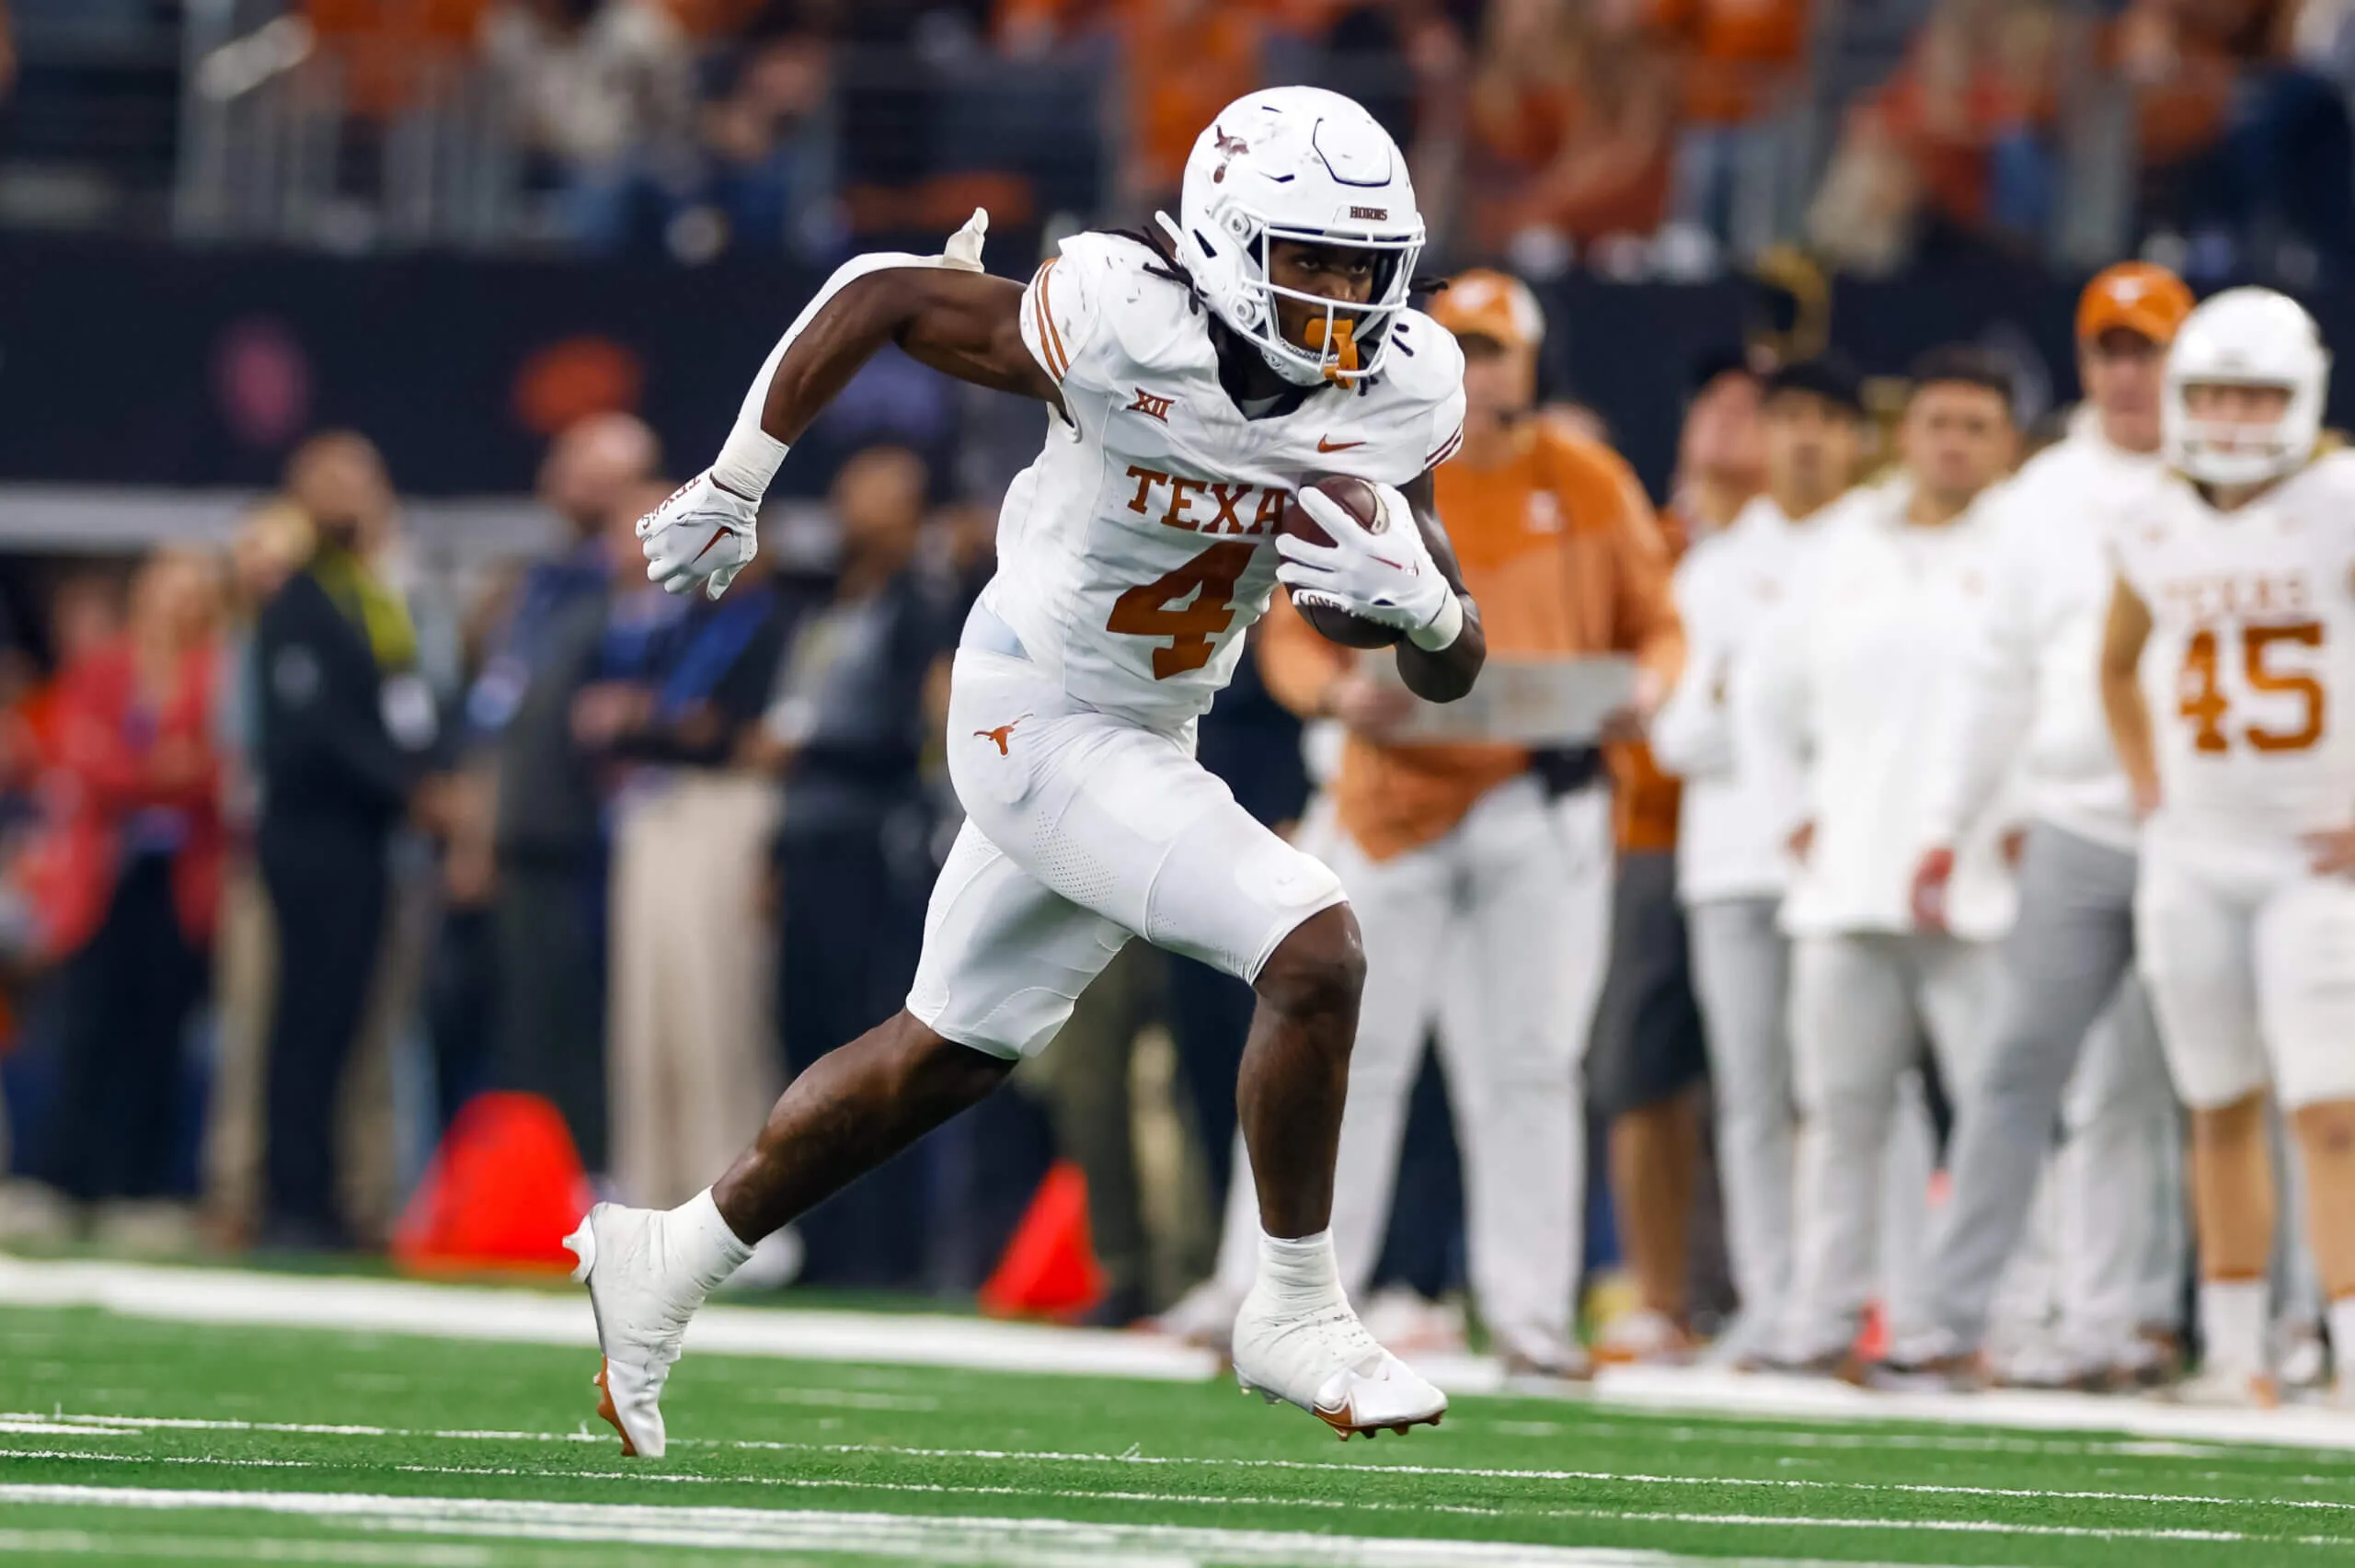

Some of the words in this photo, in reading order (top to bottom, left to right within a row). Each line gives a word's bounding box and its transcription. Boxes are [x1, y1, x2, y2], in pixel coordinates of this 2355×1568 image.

[1126, 387, 1176, 423] XII
[1125, 464, 1289, 535] TEXA
[1106, 541, 1258, 681] 4
[2178, 621, 2325, 752] 45
